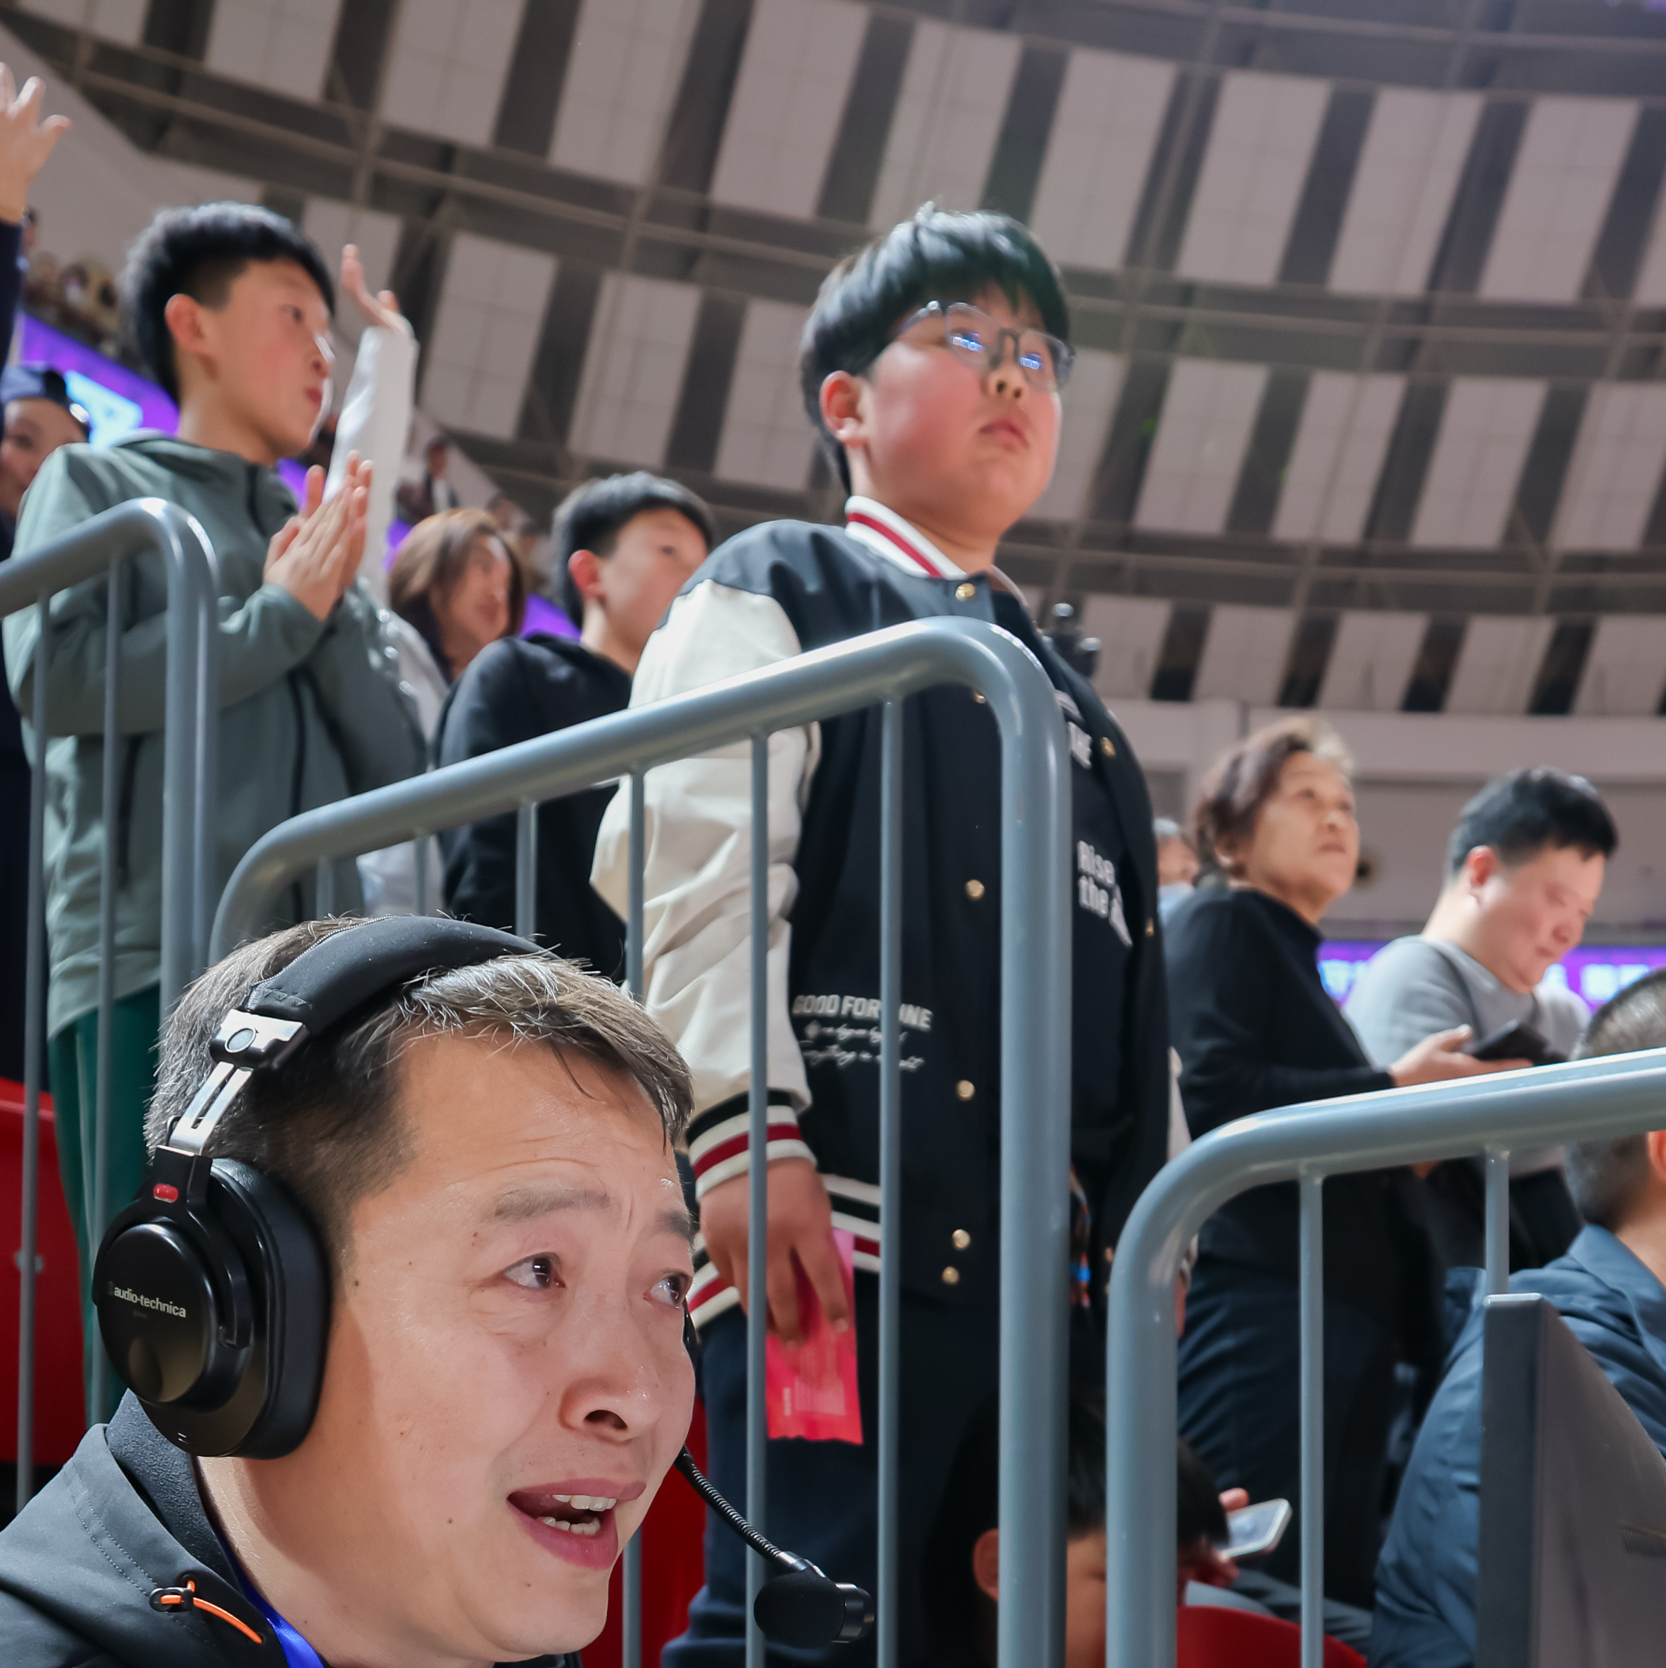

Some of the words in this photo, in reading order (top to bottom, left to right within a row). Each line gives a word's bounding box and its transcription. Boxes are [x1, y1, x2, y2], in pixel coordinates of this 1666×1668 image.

[792, 993, 841, 1019] GOOD
[841, 995, 934, 1033] FORUNE
[113, 1286, 187, 1318] audio-technica
